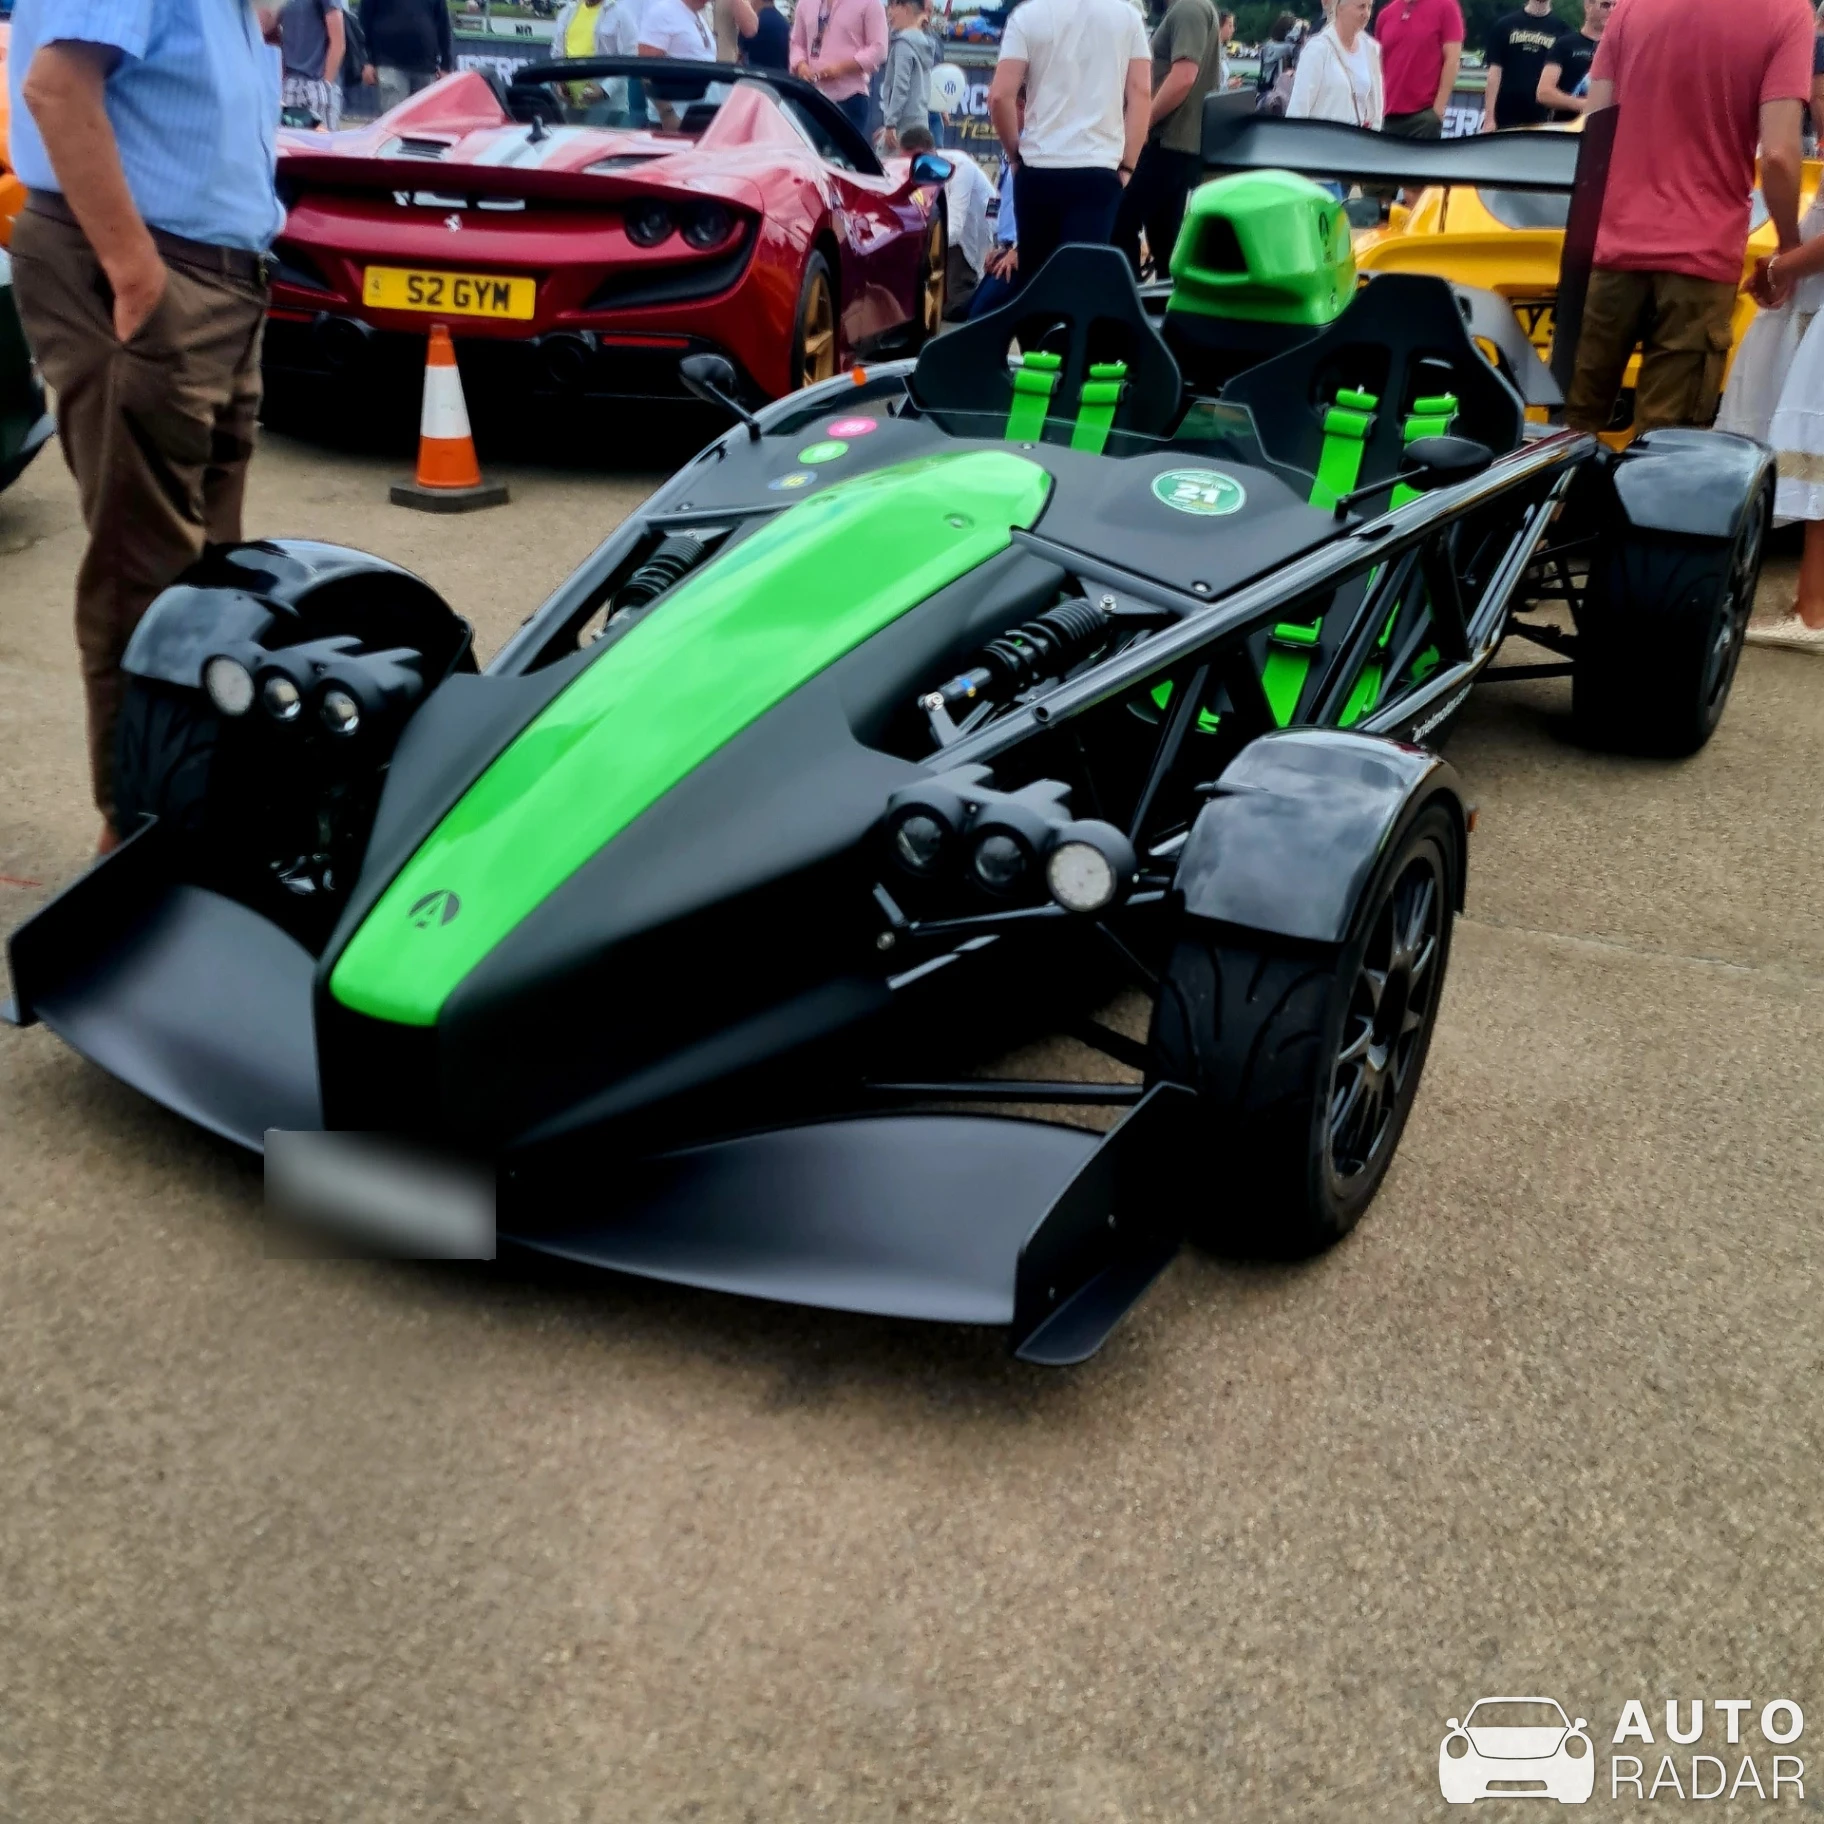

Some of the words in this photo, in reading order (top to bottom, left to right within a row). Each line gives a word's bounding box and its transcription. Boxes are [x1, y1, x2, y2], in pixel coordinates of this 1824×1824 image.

[407, 273, 445, 307] S2
[453, 278, 512, 313] GYM
[1173, 481, 1221, 505] 21
